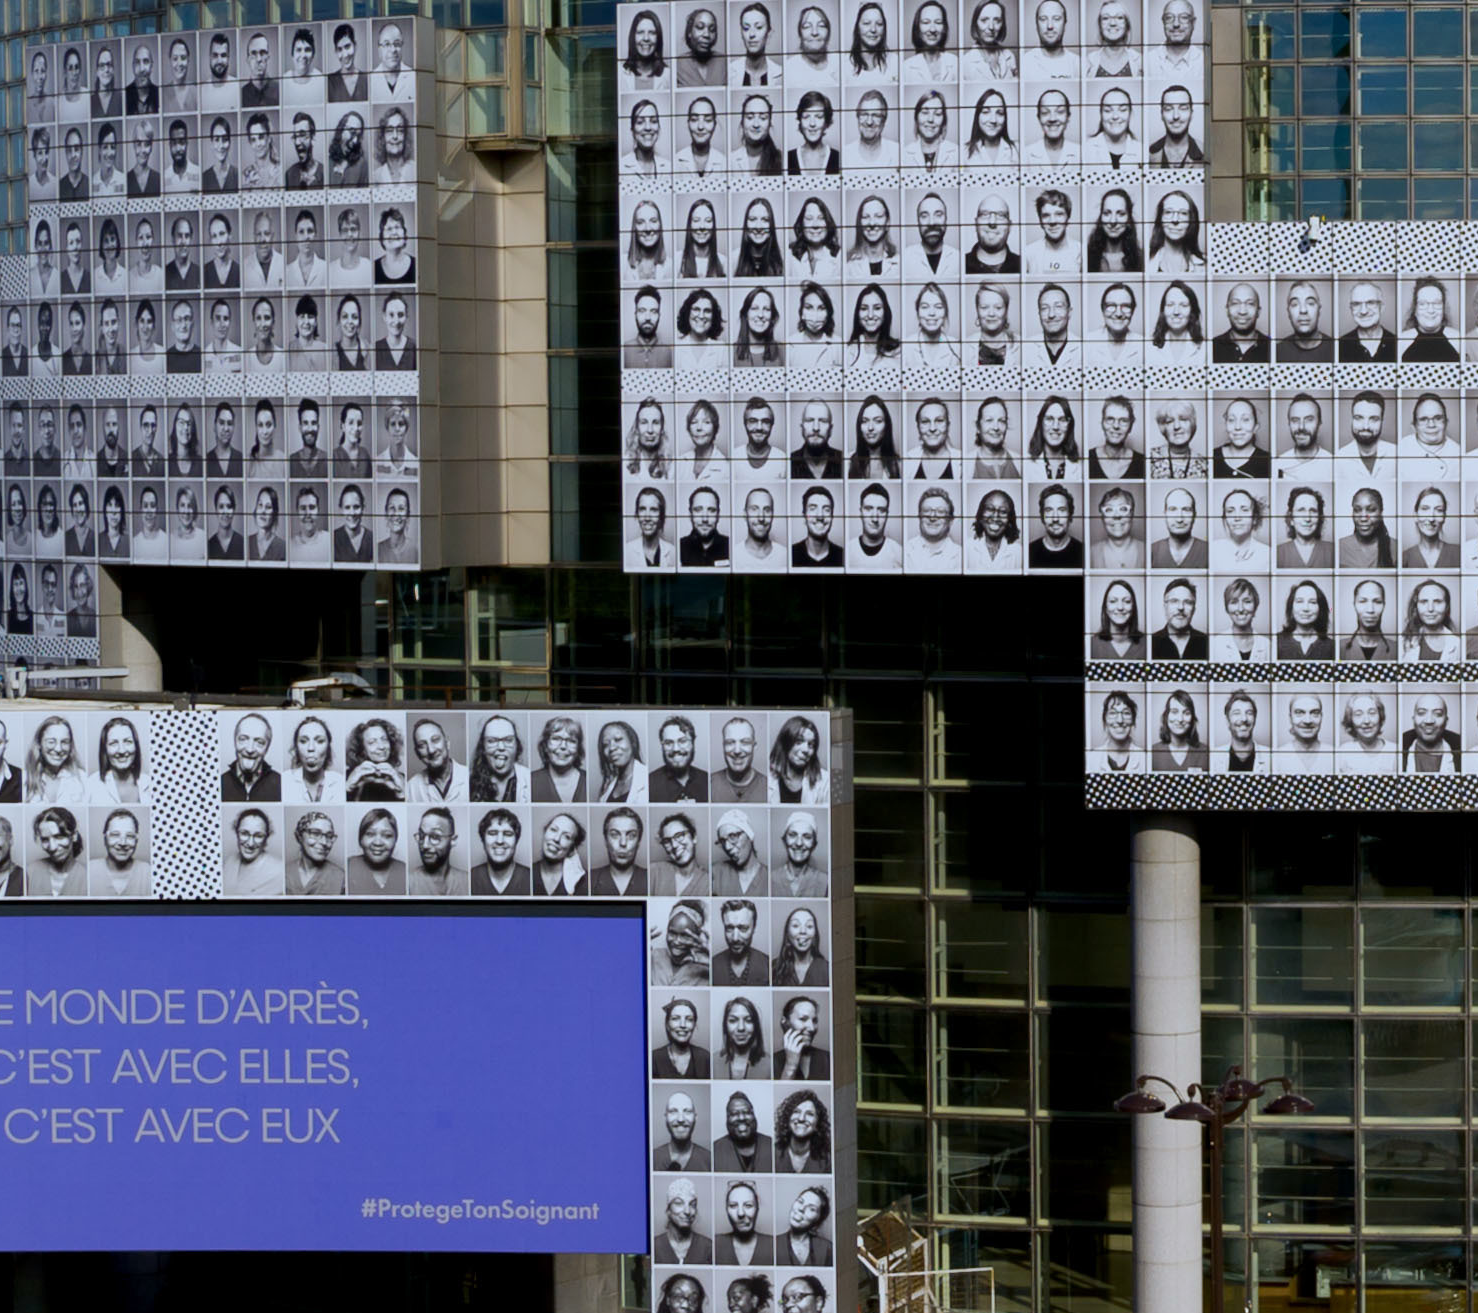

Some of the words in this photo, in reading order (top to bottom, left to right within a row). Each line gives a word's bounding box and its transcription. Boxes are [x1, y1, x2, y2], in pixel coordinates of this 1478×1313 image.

[25, 989, 186, 1025] MONDE
[196, 981, 370, 1030] D'APRÈS,
[111, 1048, 228, 1085] AVEC
[239, 1048, 360, 1089] ELLES,
[3, 1108, 124, 1144] C'EST
[133, 1108, 250, 1144] AVEC
[261, 1108, 341, 1144] EUX
[361, 1198, 600, 1226] #ProtegeTonSoignant
